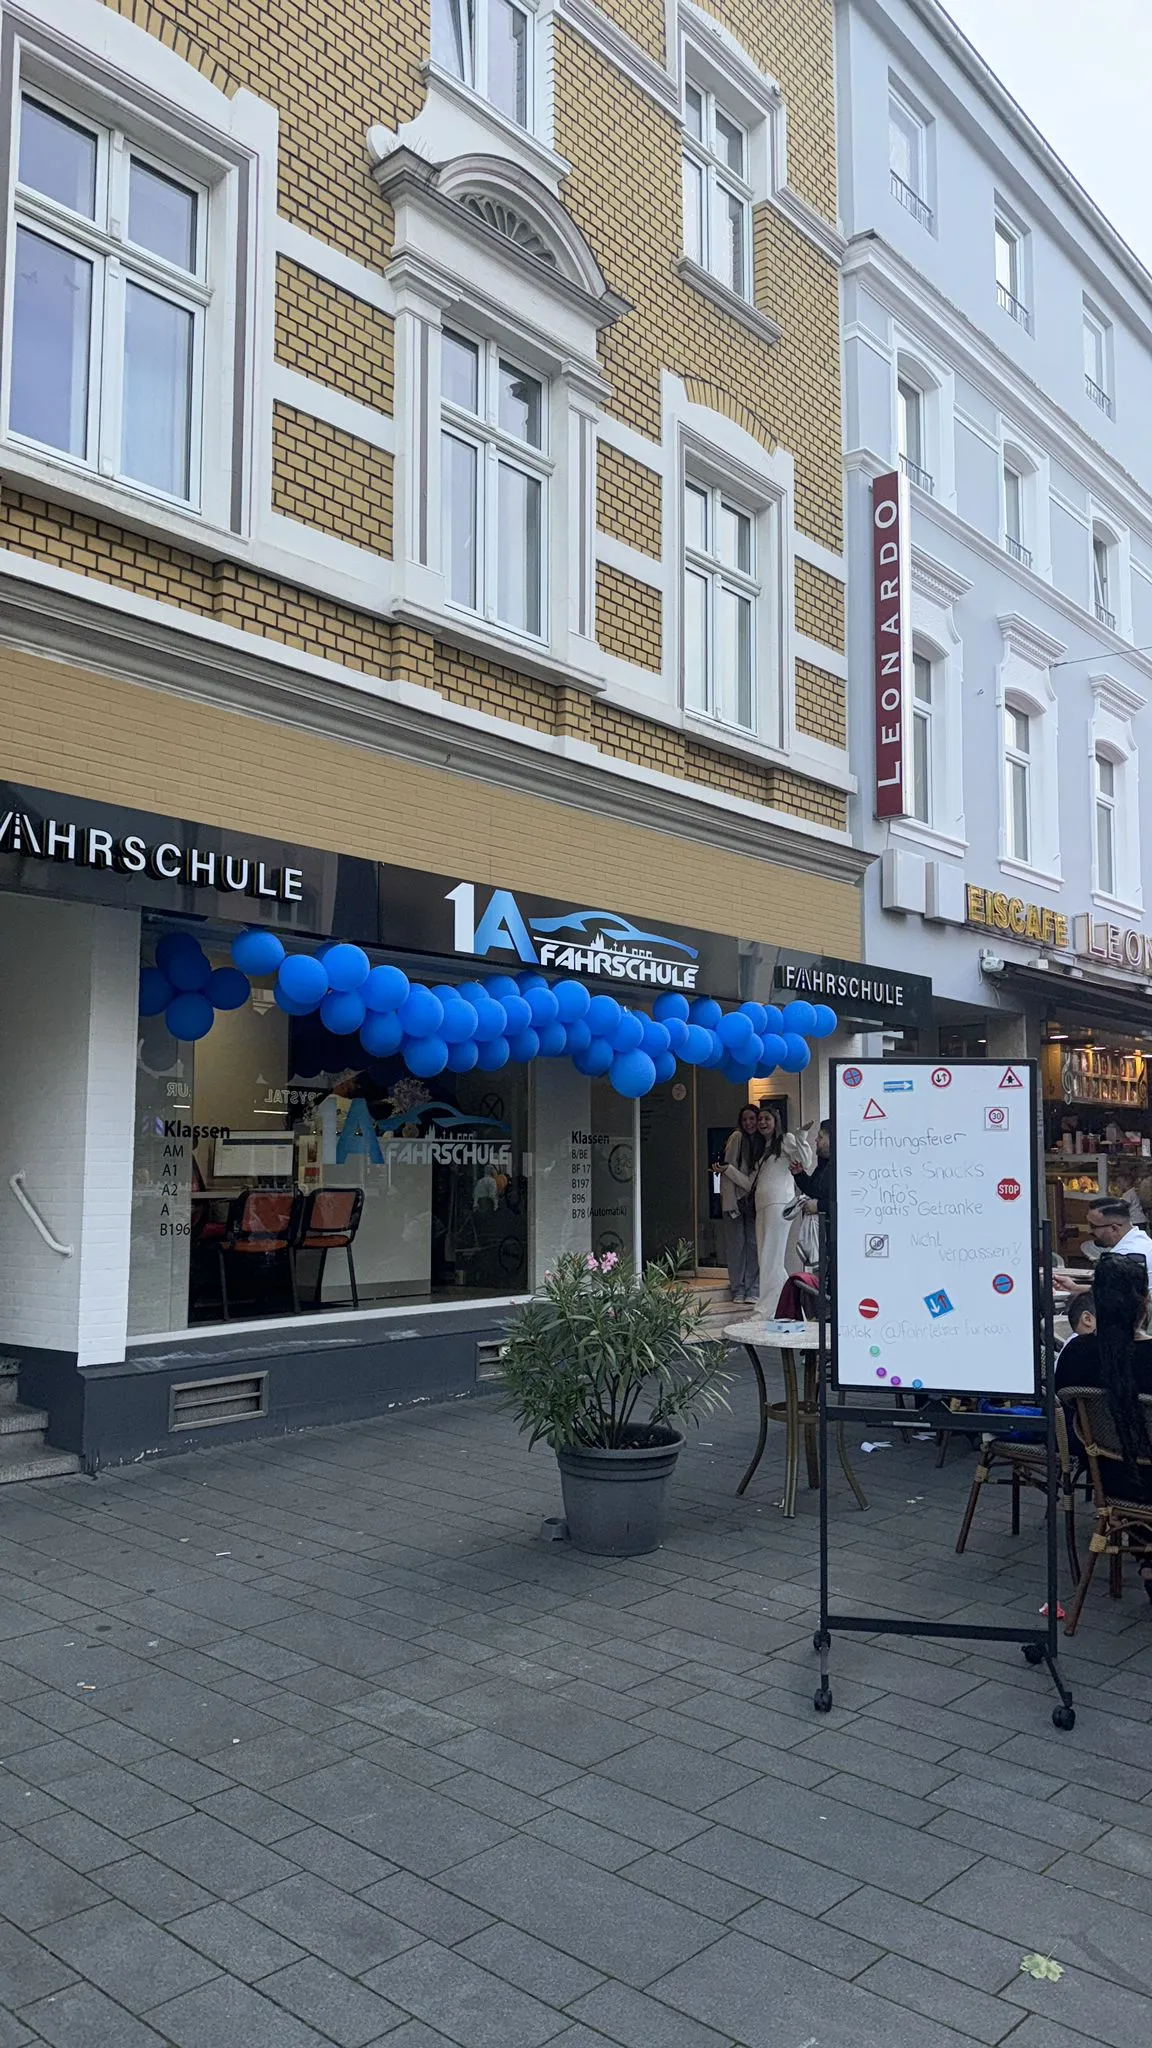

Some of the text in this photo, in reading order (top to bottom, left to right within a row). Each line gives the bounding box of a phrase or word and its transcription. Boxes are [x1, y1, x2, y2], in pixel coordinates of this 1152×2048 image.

[874, 497, 901, 789] LEONARDO
[444, 882, 540, 964] 1A
[540, 944, 698, 989] FAHRSCHULE
[786, 965, 904, 1006] FAHRSCHULE
[991, 1112, 1002, 1120] 30
[164, 1120, 230, 1139] Klassen
[318, 1094, 385, 1165] 1A
[571, 1131, 610, 1145] Klassen
[163, 1146, 184, 1158] AM
[384, 1143, 512, 1166] FAHRSCHULE
[571, 1149, 588, 1160] B/BE
[162, 1164, 177, 1177] A1
[571, 1164, 591, 1174] BF 17
[868, 1160, 985, 1189] gratis Snacks
[161, 1184, 178, 1196] A2
[571, 1179, 590, 1189] B197
[998, 1184, 1020, 1195] STOP
[571, 1194, 586, 1204] B96
[879, 1183, 918, 1207] Info's
[160, 1204, 170, 1216] A
[571, 1206, 628, 1219] B78 (Automatik)
[875, 1203, 909, 1225] gratis
[160, 1223, 191, 1237] B196
